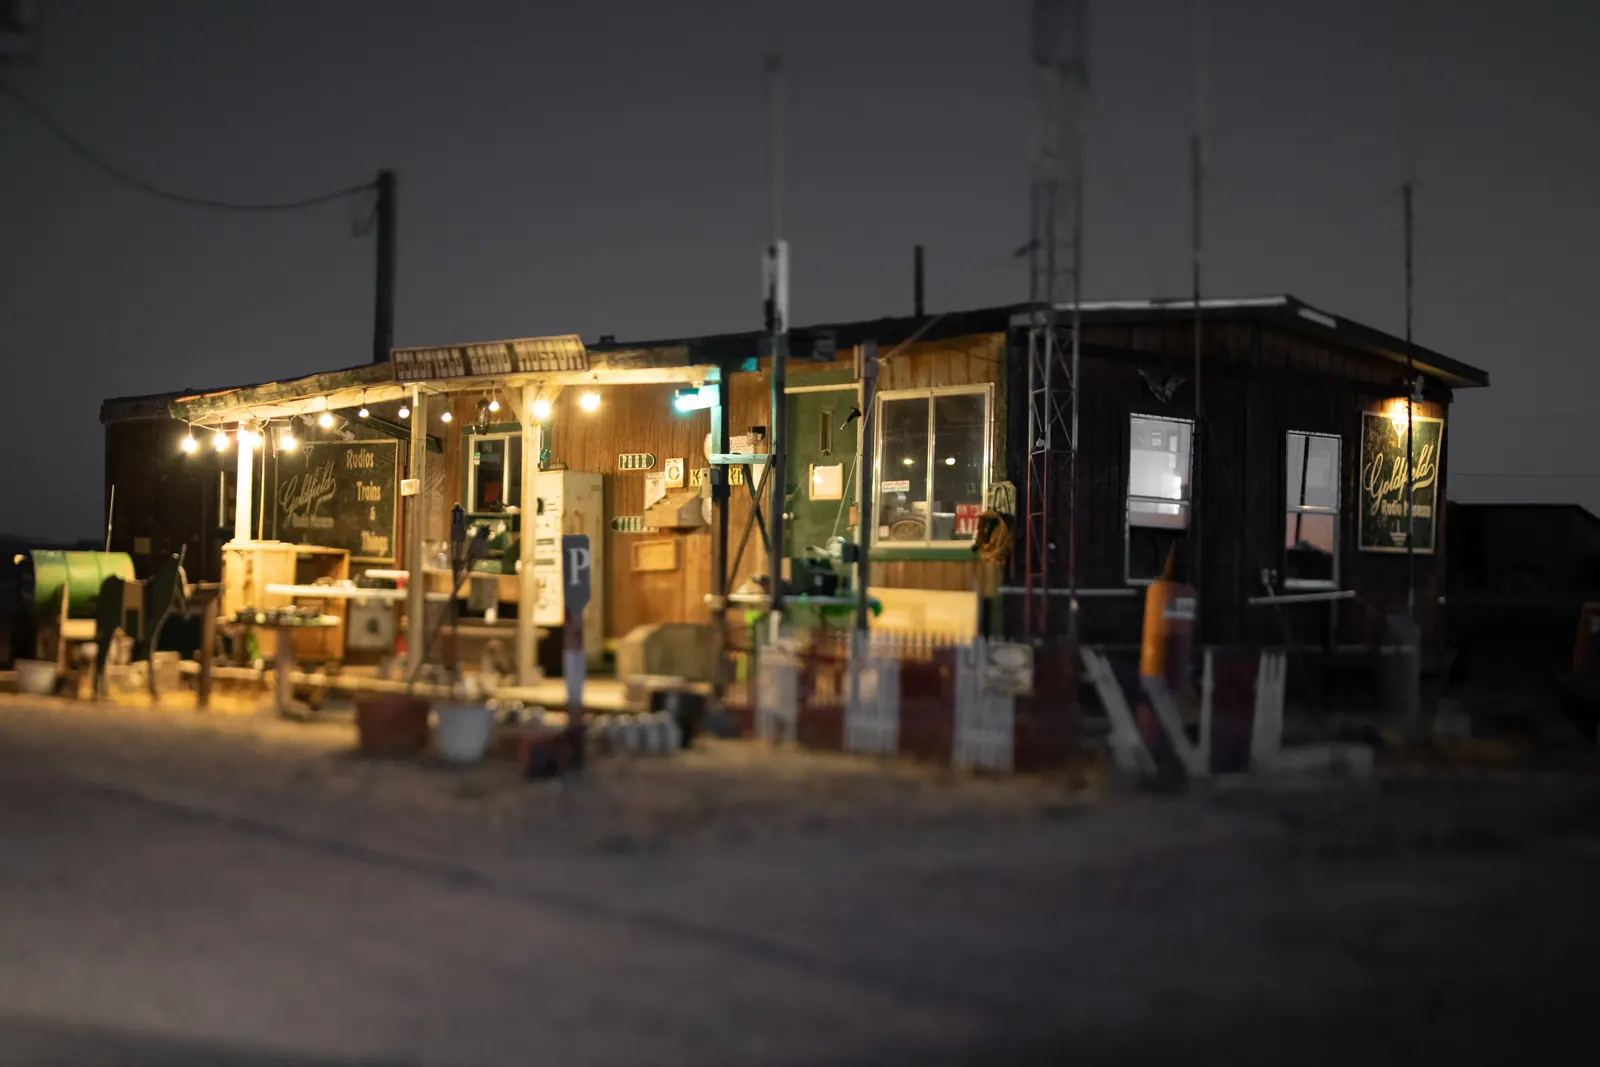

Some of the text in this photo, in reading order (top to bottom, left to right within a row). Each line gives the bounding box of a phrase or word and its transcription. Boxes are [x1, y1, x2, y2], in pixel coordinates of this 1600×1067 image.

[346, 449, 375, 469] Radios
[1363, 444, 1435, 516] Goldfeld
[356, 481, 381, 501] Trains
[1381, 500, 1402, 516] Radio
[568, 548, 590, 585] P
